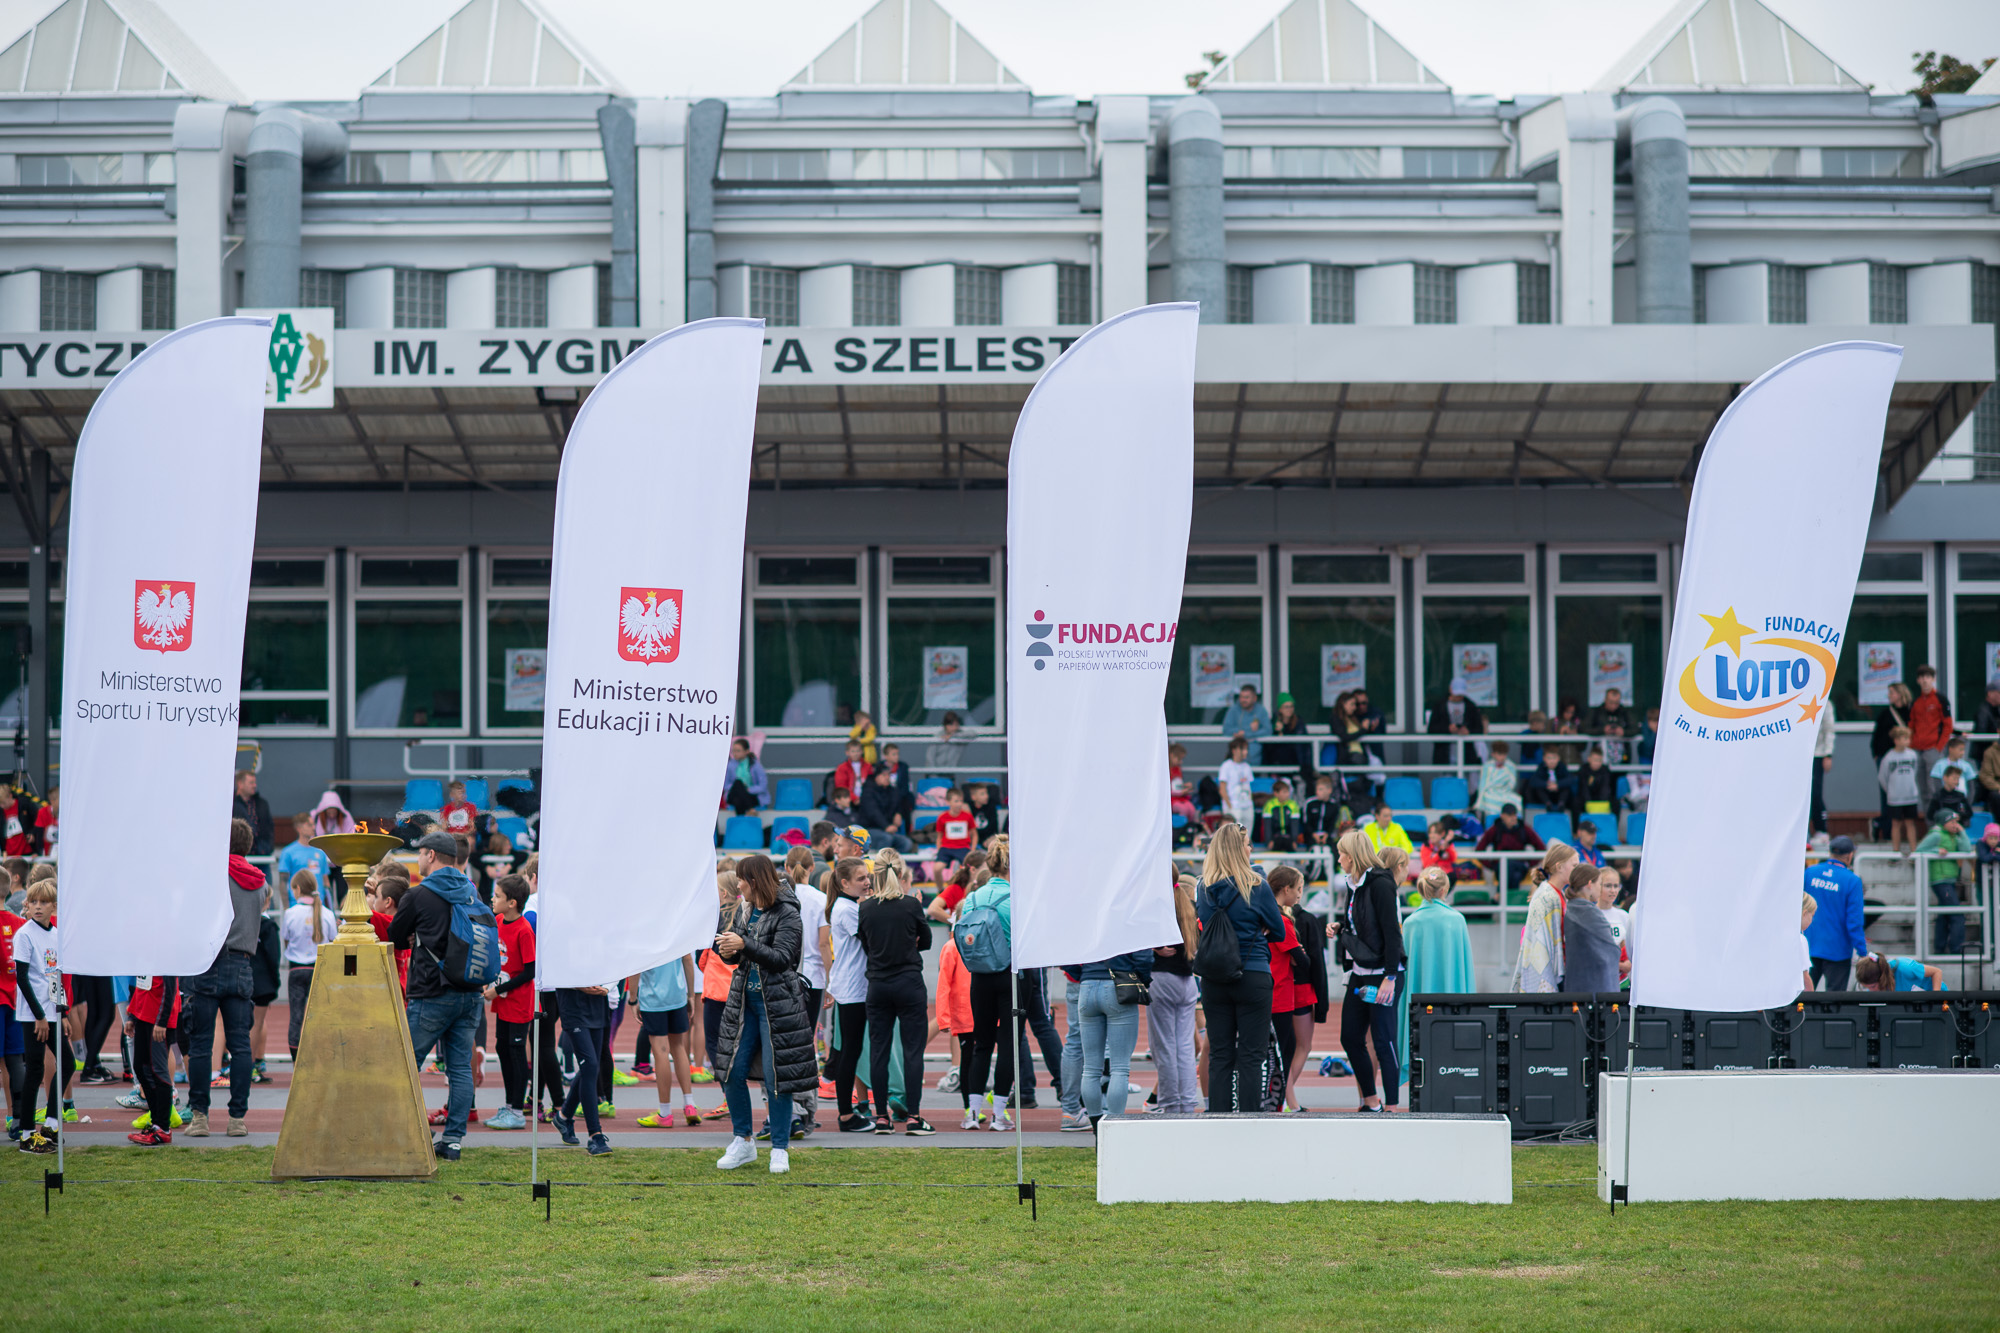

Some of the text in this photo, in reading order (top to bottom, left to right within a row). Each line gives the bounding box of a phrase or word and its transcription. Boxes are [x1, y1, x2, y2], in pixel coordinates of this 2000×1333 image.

[0, 342, 148, 378] YCZ
[373, 340, 455, 375] IM.
[269, 313, 304, 402] AWF
[1058, 622, 1177, 644] FUNDACJA
[1765, 616, 1841, 648] FUNDACJA
[1058, 647, 1148, 659] POLSKIEJ WYTWÓRNI
[1058, 660, 1100, 671] PAPIERÓW
[100, 670, 222, 693] Ministerstwo
[573, 678, 719, 704] Ministerstwo
[1715, 654, 1811, 702] LOTTO
[76, 699, 239, 727] Sportu i Turystyk
[557, 708, 730, 736] Edukacji i Nauki
[1674, 713, 1792, 742] im. H. KONOPACKIEJ
[468, 923, 490, 980] PUMA
